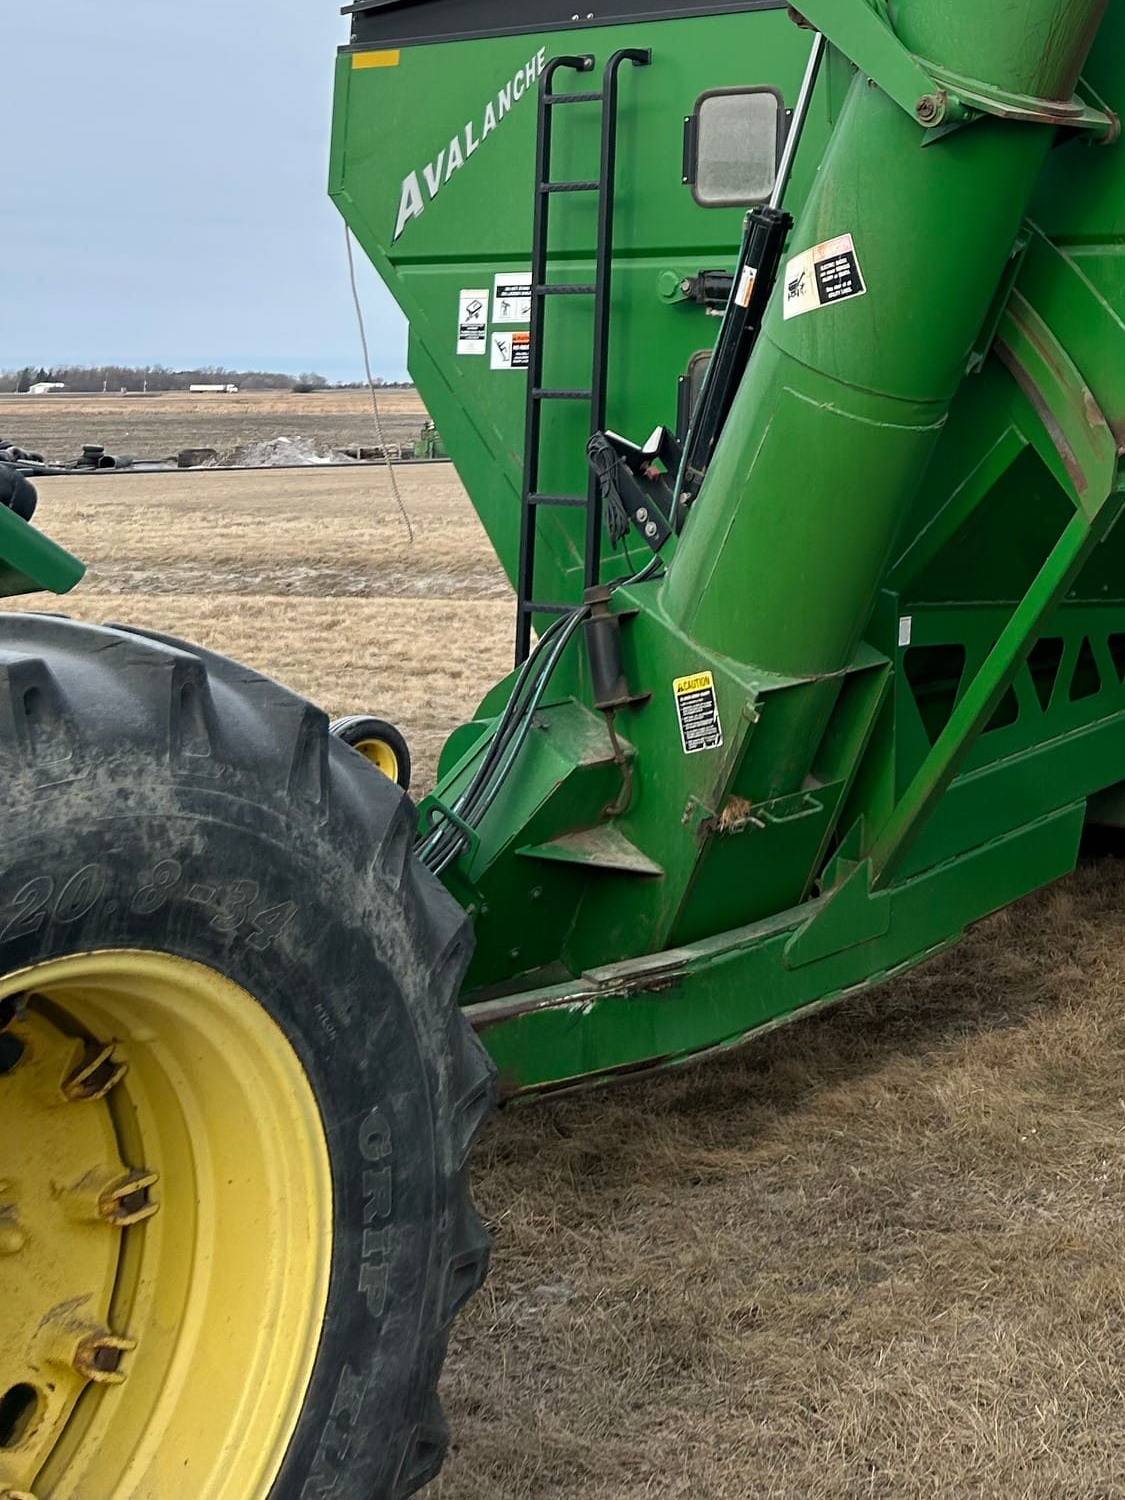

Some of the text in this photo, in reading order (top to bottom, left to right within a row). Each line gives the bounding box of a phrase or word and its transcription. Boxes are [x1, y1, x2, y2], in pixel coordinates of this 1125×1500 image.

[391, 46, 546, 243] AVALANCHE
[683, 676, 710, 690] CAUTION
[358, 1106, 393, 1318] GRIP
